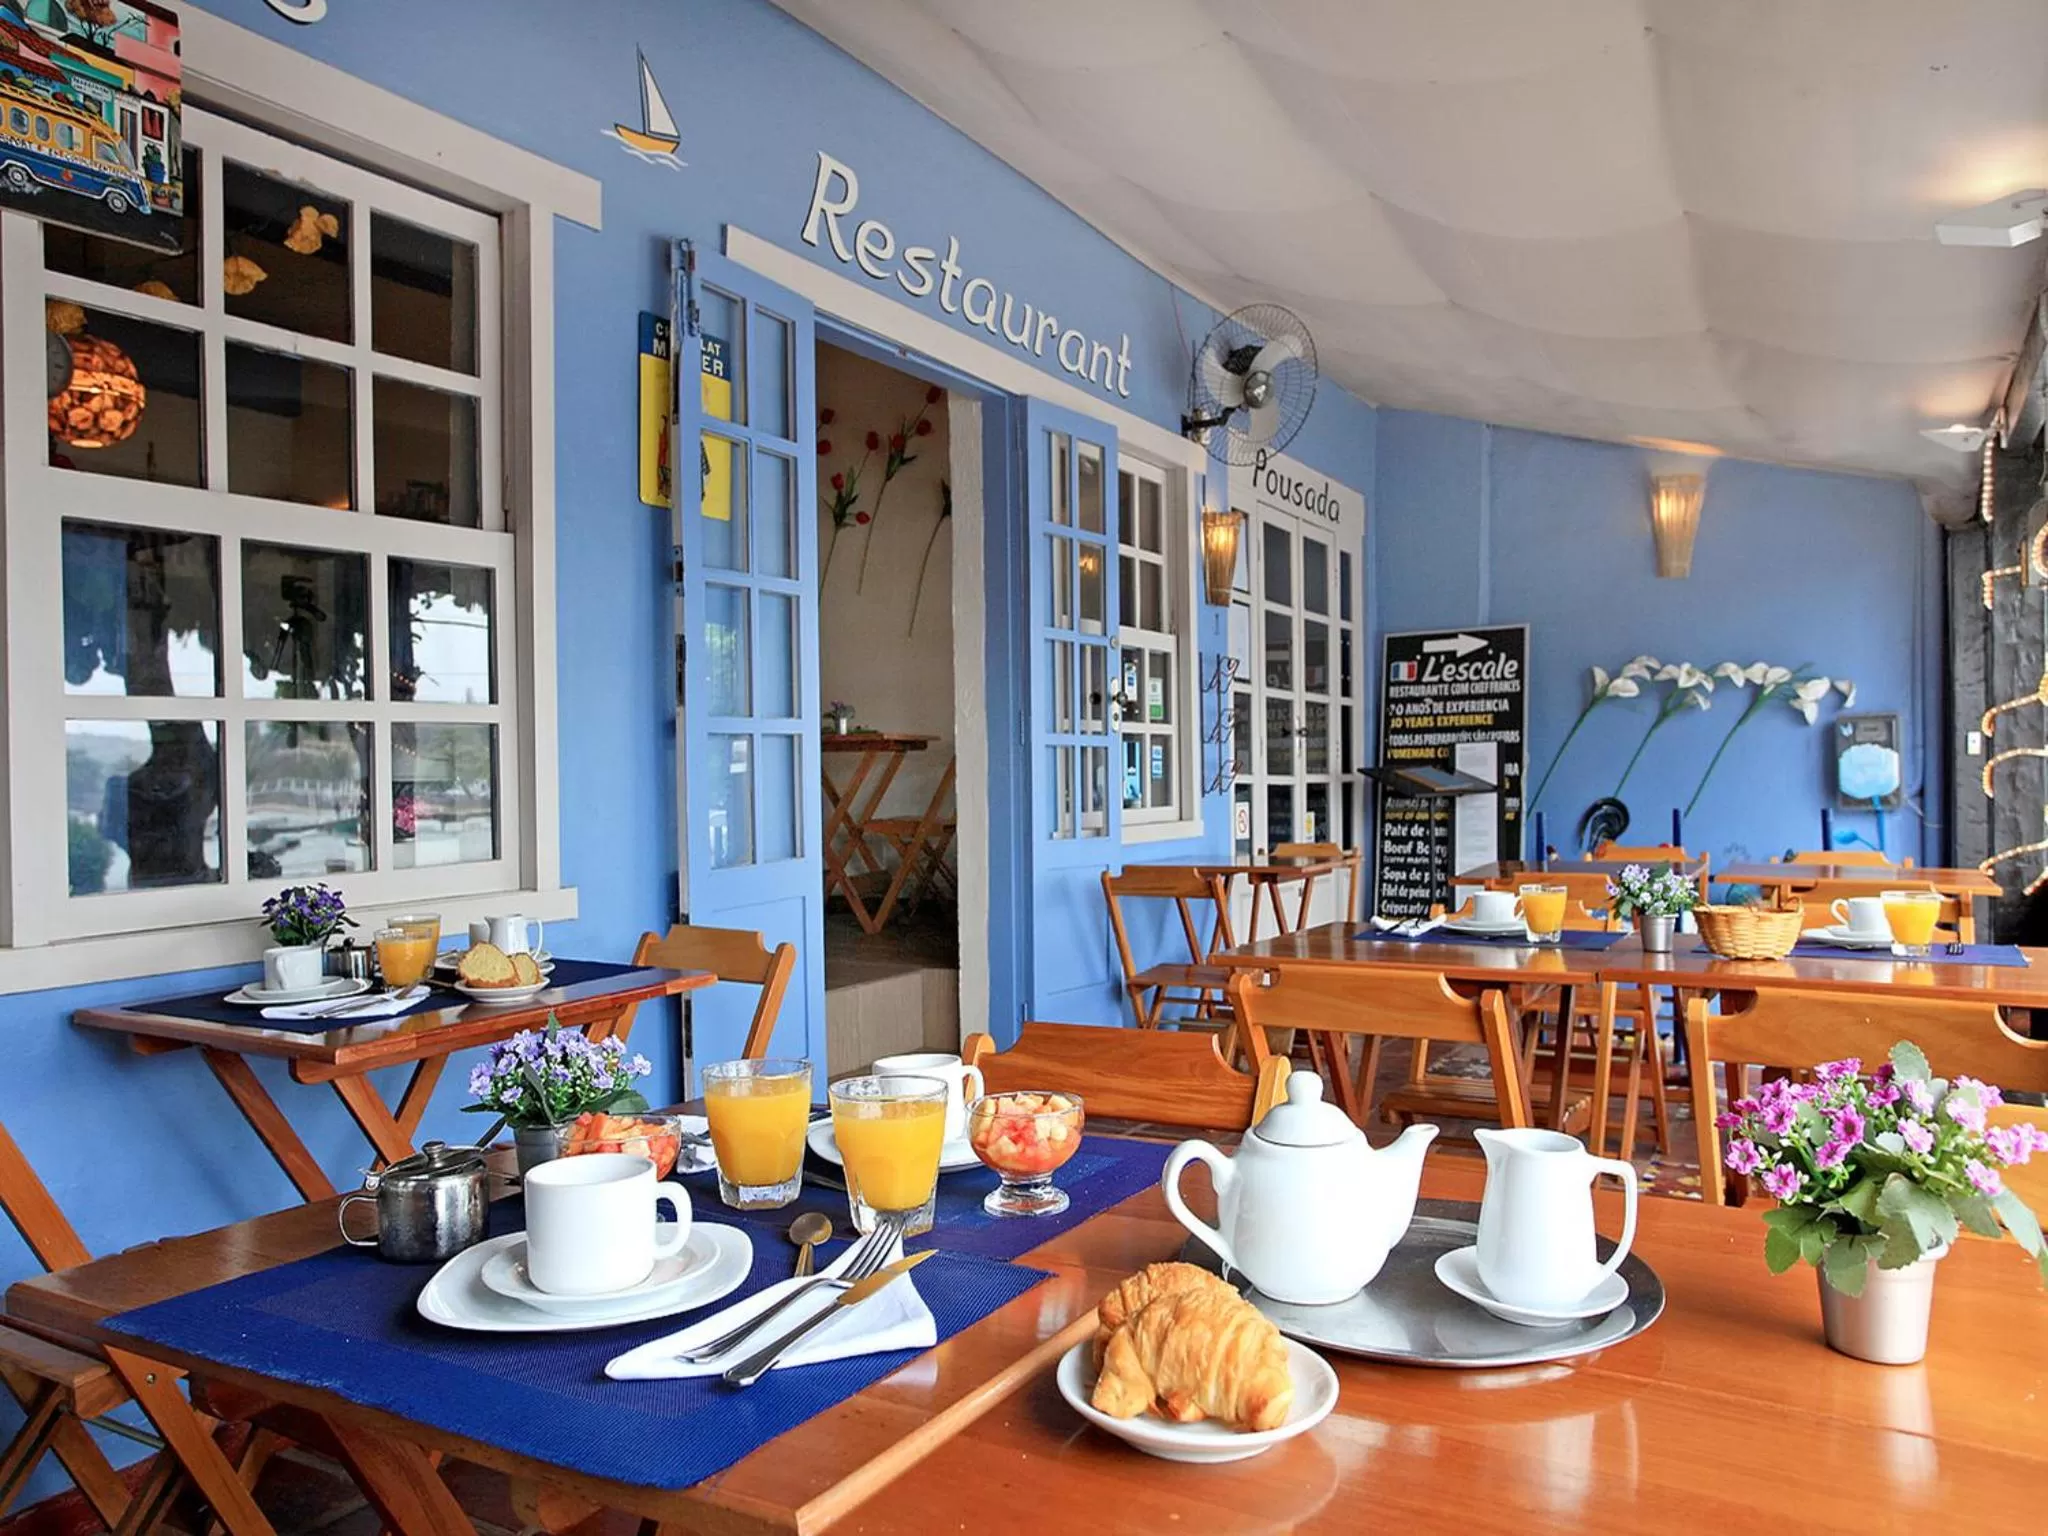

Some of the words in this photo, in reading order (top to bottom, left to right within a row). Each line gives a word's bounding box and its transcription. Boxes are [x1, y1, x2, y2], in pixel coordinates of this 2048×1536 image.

[801, 151, 1131, 398] Restaurant
[1253, 448, 1340, 524] Pousada
[1422, 652, 1518, 682] L'escale
[1389, 684, 1449, 698] RESTAURANTE
[1404, 716, 1434, 728] YEARS
[1437, 714, 1494, 726] EXPERIENCE
[1410, 824, 1424, 837] de
[1410, 867, 1424, 880] de
